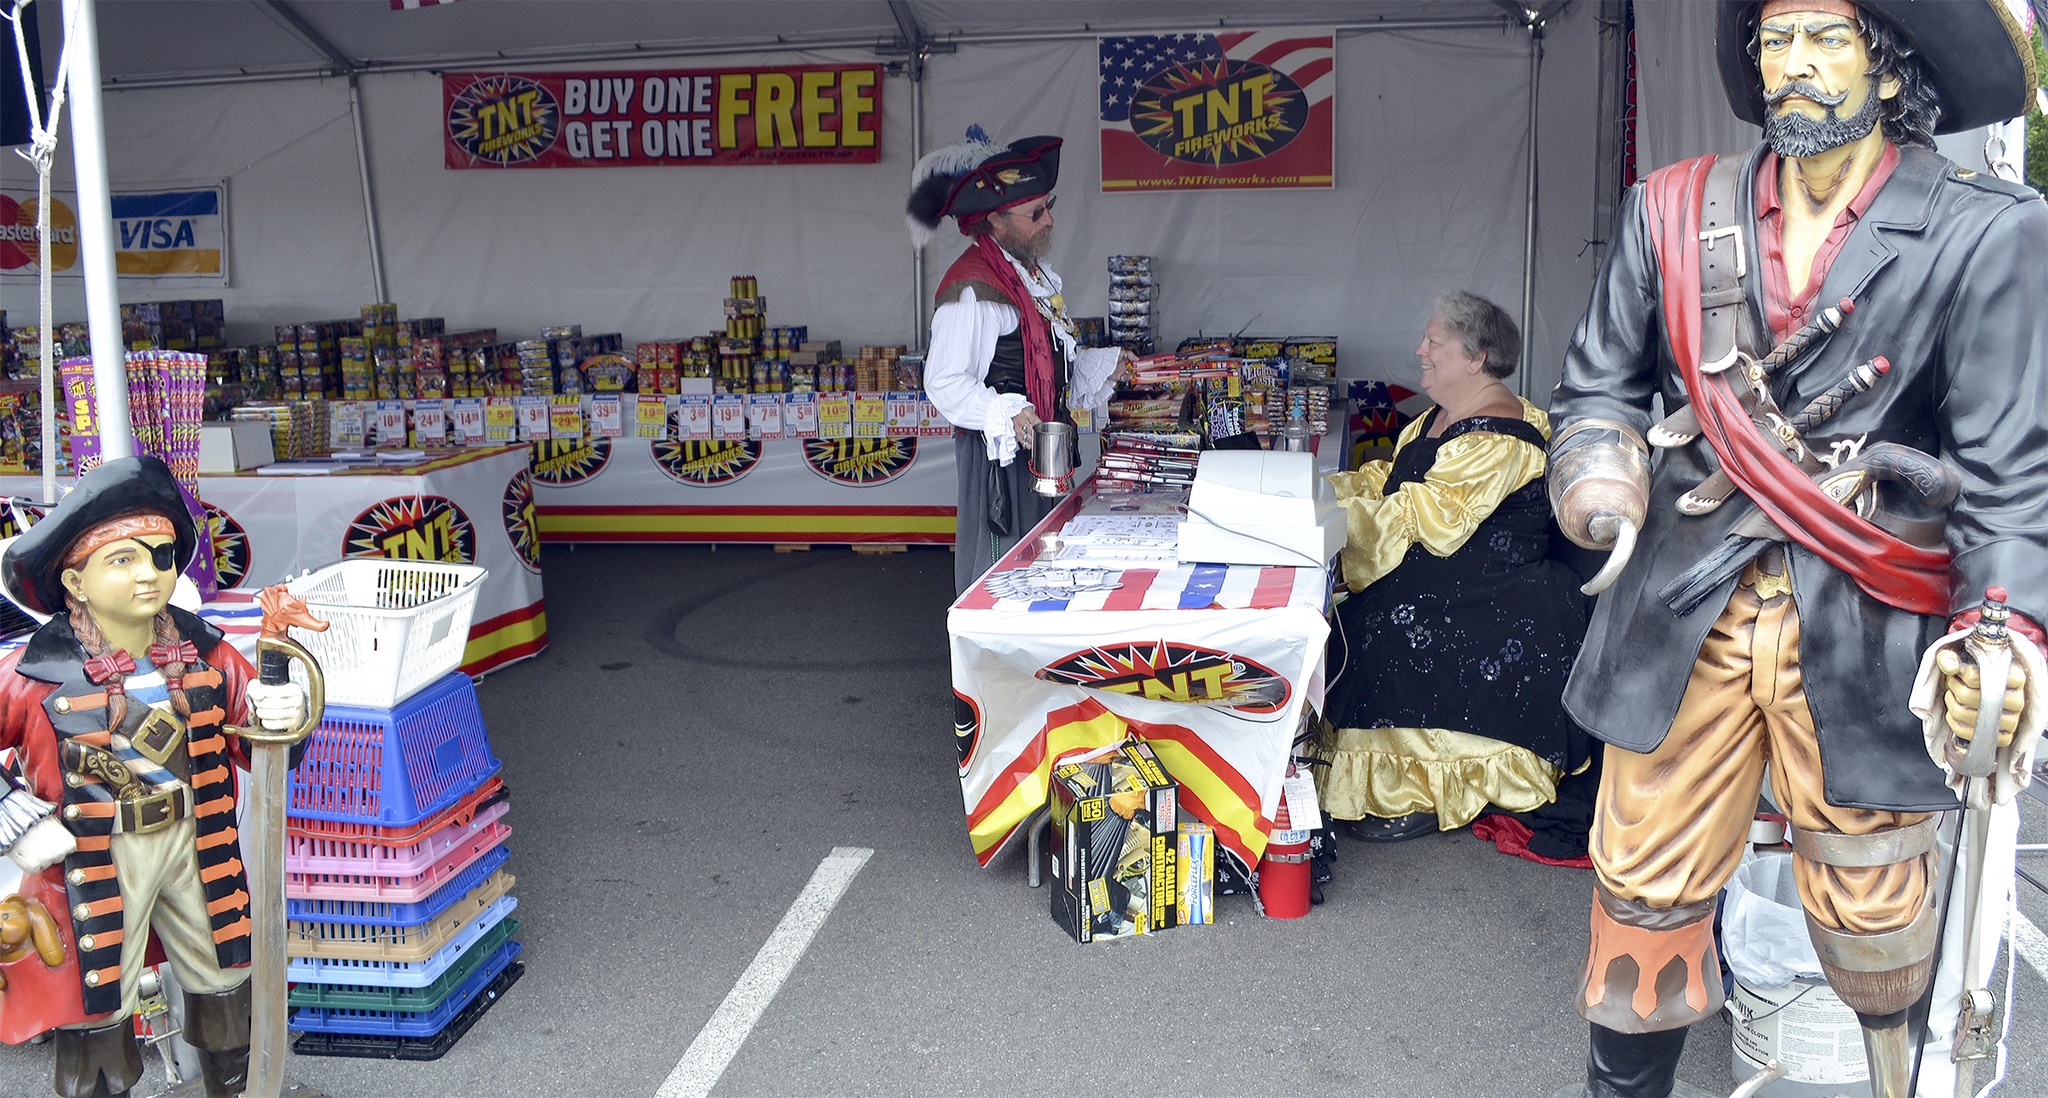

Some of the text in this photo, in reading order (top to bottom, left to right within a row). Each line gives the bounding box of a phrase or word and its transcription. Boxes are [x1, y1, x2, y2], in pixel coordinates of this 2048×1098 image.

[478, 90, 537, 141] TNT
[564, 76, 713, 116] BUY ONE
[718, 69, 875, 149] FREE
[1172, 72, 1273, 139] TNT
[478, 123, 543, 155] FIREWORKS
[565, 118, 713, 158] GET ONE
[1174, 113, 1281, 156] FIREWORKS
[1137, 175, 1298, 187] www.TNTFireworks.com
[119, 219, 195, 249] VISA
[1233, 406, 1242, 436] OPPERS
[533, 446, 593, 475] FIREWORKS
[681, 446, 742, 474] FIREWORKS
[833, 446, 896, 474] FIREWORKS
[382, 508, 452, 561] TNT
[1091, 800, 1102, 818] 50
[1155, 835, 1166, 906] CONTRACTOR
[1165, 847, 1176, 905] 42 GALLON
[1189, 857, 1199, 905] FORCEFLEX
